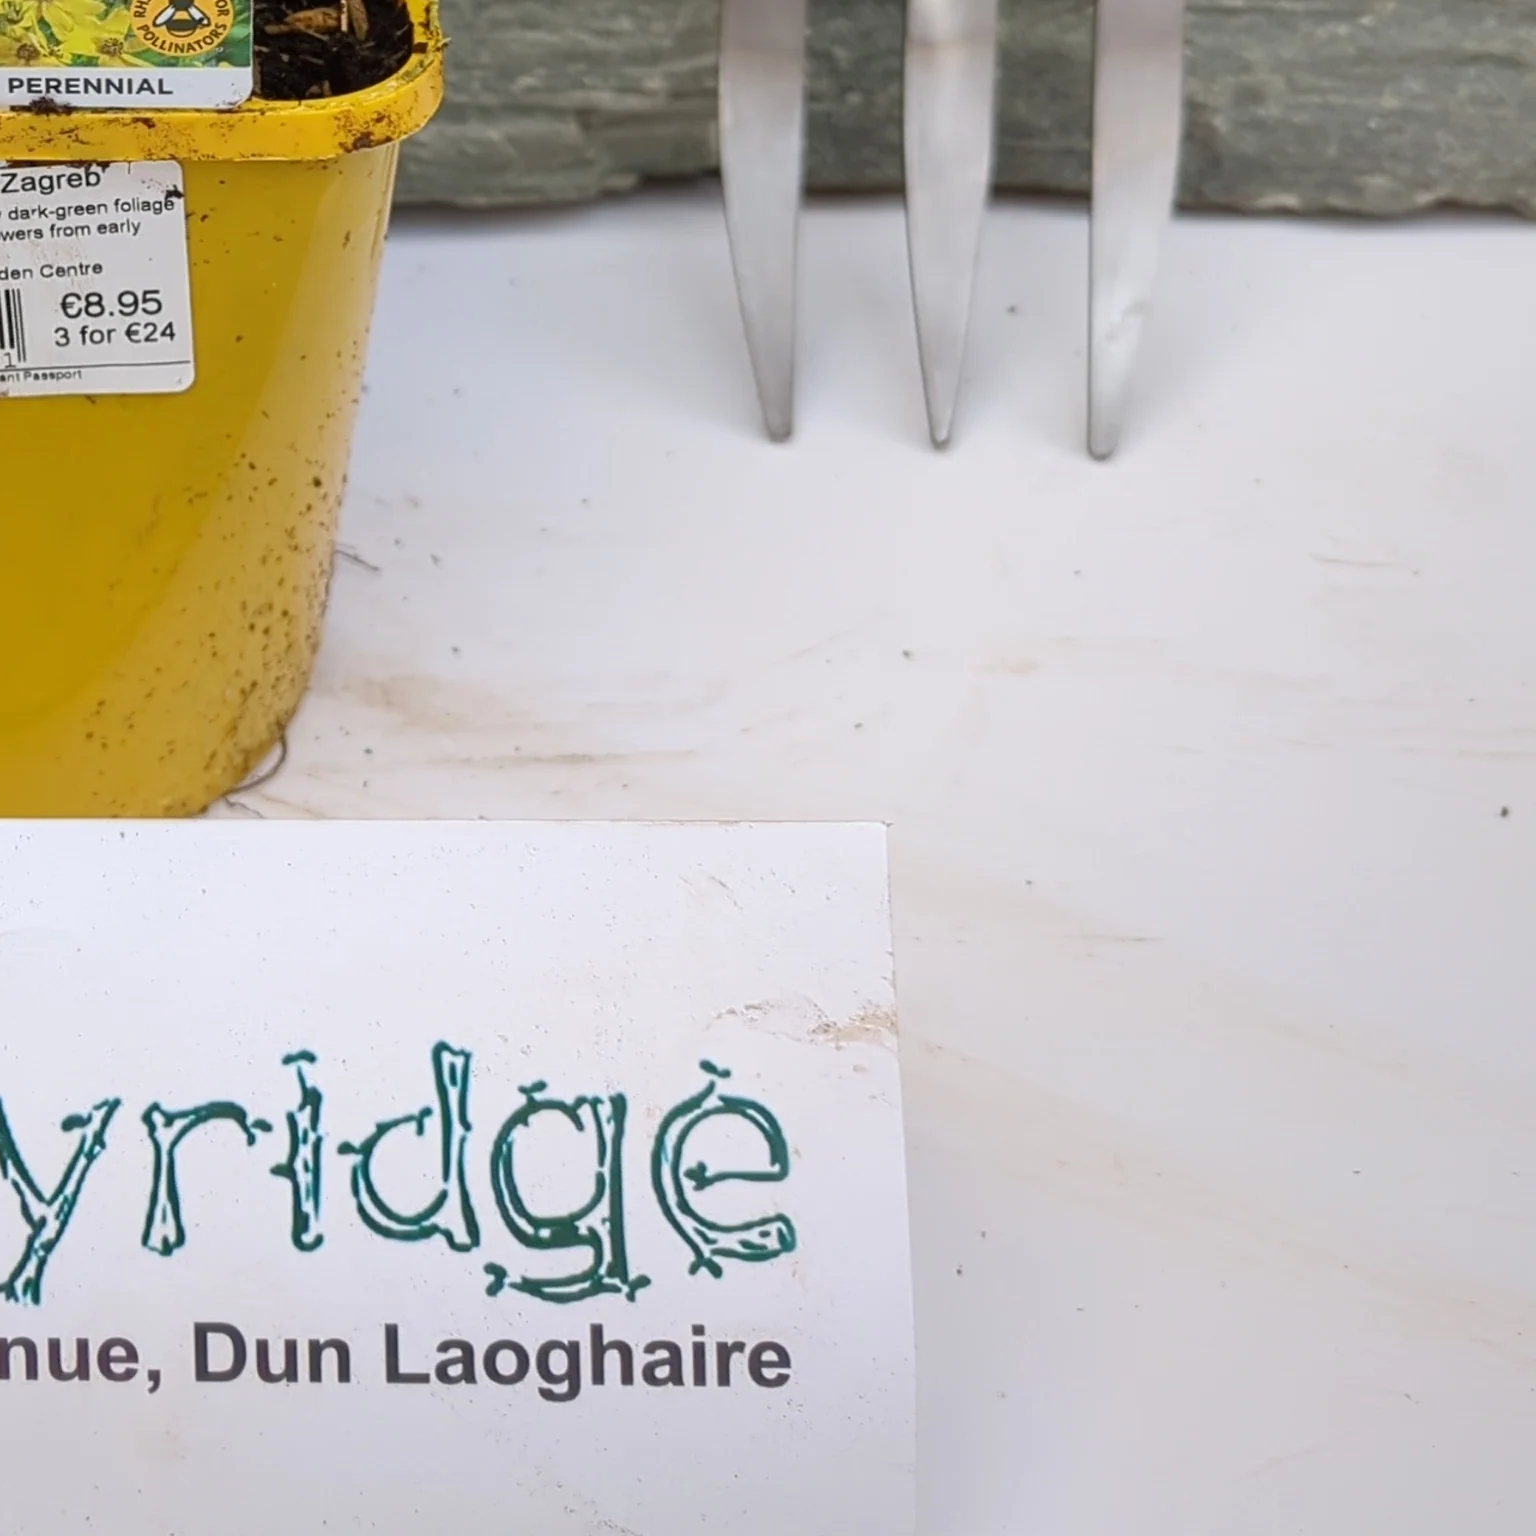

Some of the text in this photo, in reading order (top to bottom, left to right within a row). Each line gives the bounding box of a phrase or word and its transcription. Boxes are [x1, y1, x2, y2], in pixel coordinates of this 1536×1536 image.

[137, 22, 227, 54] POLLINATORS
[7, 75, 174, 96] PERENNIAL
[7, 200, 108, 221] dark-green
[113, 196, 175, 215] foliage
[49, 223, 91, 238] from
[96, 219, 141, 237] early
[39, 262, 103, 279] Centre
[60, 289, 162, 319] €8.95
[54, 321, 176, 347] 3 for €24
[24, 369, 82, 382] Passport
[194, 1321, 351, 1385] Dun
[384, 1322, 792, 1403] Laoghaire
